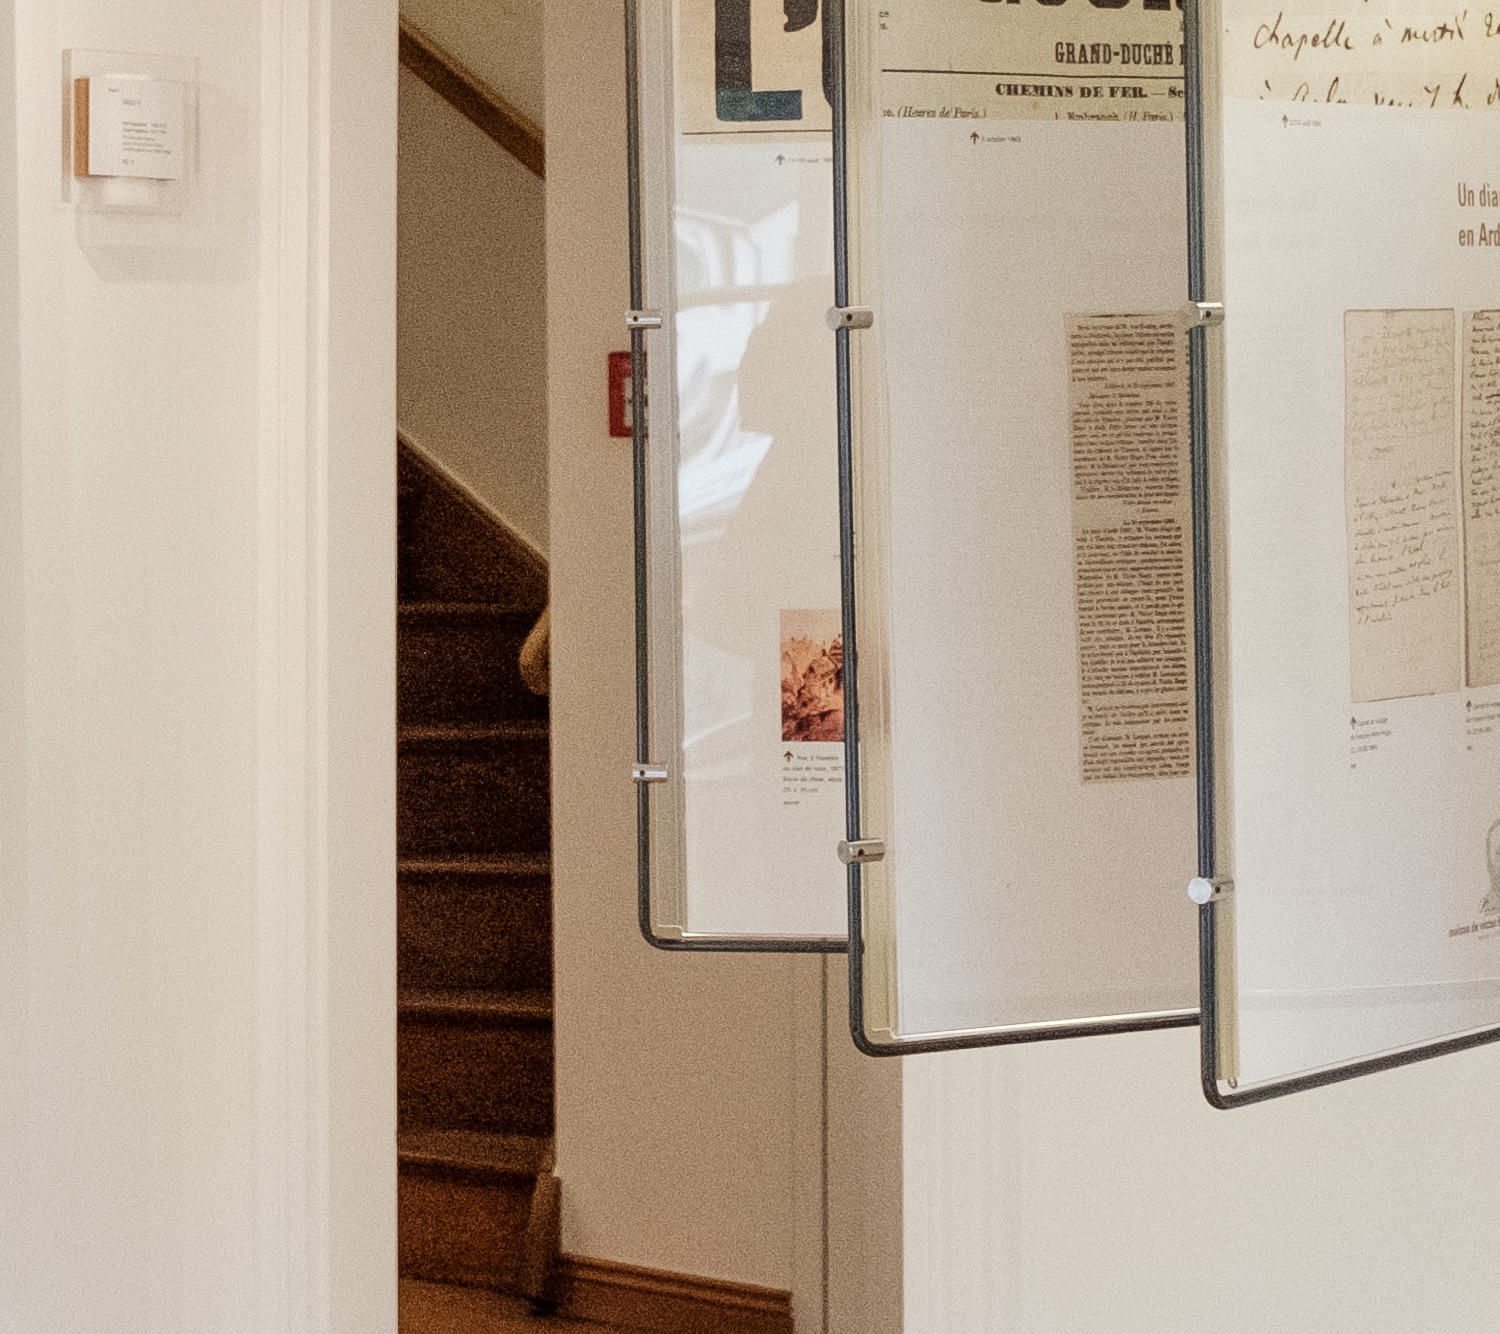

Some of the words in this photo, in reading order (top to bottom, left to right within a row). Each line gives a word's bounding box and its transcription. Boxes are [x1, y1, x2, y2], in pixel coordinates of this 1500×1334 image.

[1054, 40, 1175, 65] GRAND-DUCHÉ
[995, 83, 1074, 99] CHEMINS
[1080, 85, 1105, 100] DE
[1109, 86, 1149, 100] FER.
[1458, 182, 1475, 207] Un
[1458, 229, 1475, 247] en
